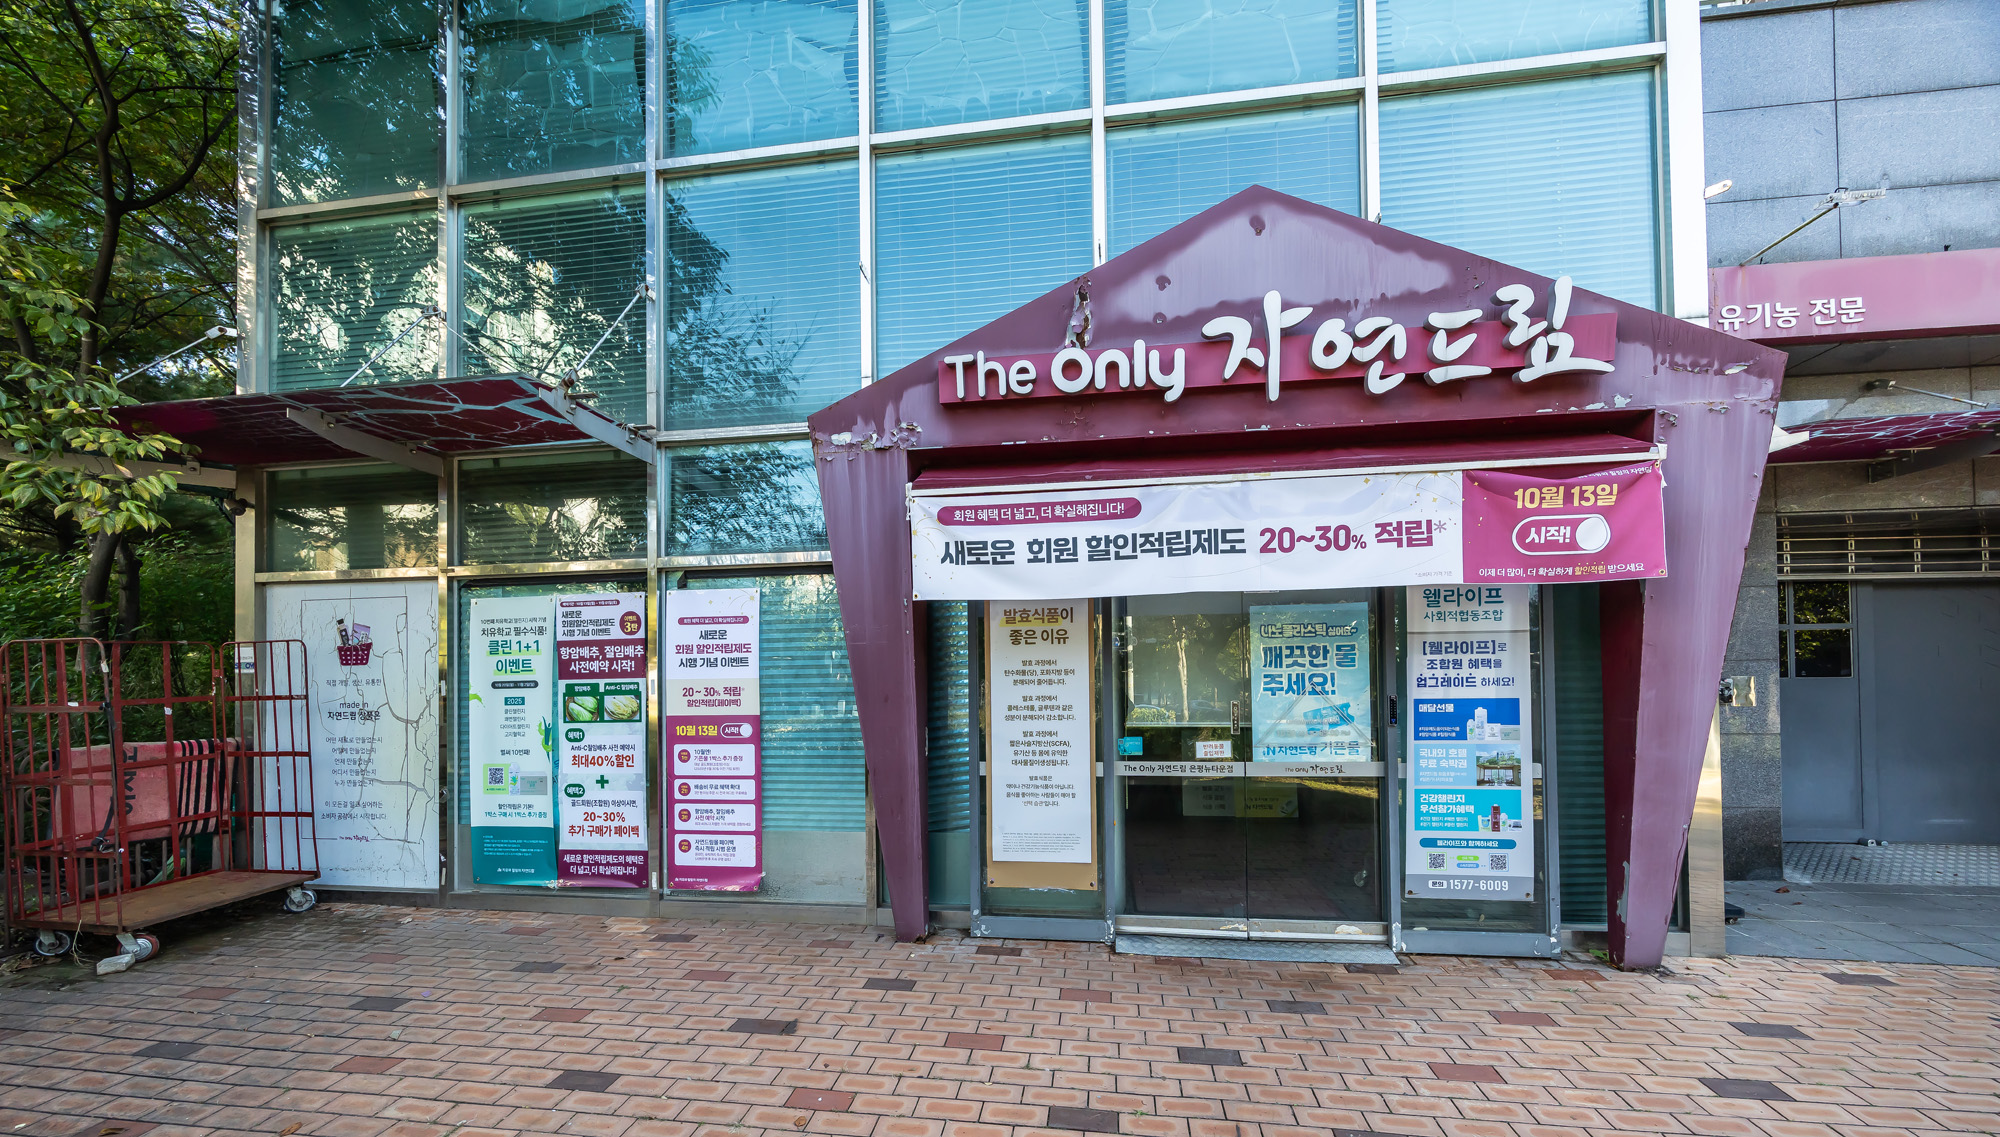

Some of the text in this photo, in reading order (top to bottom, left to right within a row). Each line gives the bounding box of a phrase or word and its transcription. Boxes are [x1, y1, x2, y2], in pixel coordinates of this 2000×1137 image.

[1718, 297, 1867, 331] 유기농 전문
[943, 275, 1616, 402] The Only 자연드림
[1514, 483, 1618, 509] 10월 13일
[953, 502, 1125, 522] 회원 혜택 더 넓고, 더 확실해집니다!
[1525, 526, 1571, 544] 시작!
[941, 539, 1015, 566] 새로운
[1027, 536, 1078, 564] 회원
[1085, 528, 1247, 562] 할인적립제도
[1259, 524, 1367, 554] 20~30%
[1479, 563, 1645, 578] 이제 더 많이, 더 확실하게 할인적립 받으세요
[1422, 586, 1504, 608] 웰라이프
[562, 610, 582, 619] 새로운
[1004, 607, 1074, 625] 발효식품이
[1424, 609, 1504, 622] 사회적협동조합
[562, 619, 615, 628] 회원할인적립제도
[624, 622, 638, 633] 3탄
[481, 626, 547, 637] 치유학교 필수식품!
[562, 628, 611, 637] 시행 기념 이벤트
[699, 629, 727, 640] 새로운
[1260, 623, 1327, 638] 나노플라스틱
[1009, 628, 1069, 646] 좋은 이유
[488, 639, 540, 655] 클린 1+1
[560, 645, 644, 660] 항암배추, 절임배추
[675, 643, 752, 655] 회원 할인적립제도
[1422, 640, 1507, 656] [웰라이프]로
[679, 656, 749, 668] 시행 기념 이벤트
[1262, 643, 1357, 669] 깨끗한 물
[496, 658, 533, 674] 이벤트
[569, 659, 635, 674] 사전예약 시작!
[1426, 658, 1502, 670] 조합원 혜택을
[1063, 668, 1075, 676] 등이
[1262, 672, 1336, 697] 주세요!
[1416, 676, 1515, 688] 업그레이드 하세요!
[340, 701, 360, 709] made
[687, 699, 741, 707] 할인적립(페이백)
[1418, 703, 1454, 713] 매달선물
[328, 711, 357, 721] 자연드림
[568, 731, 583, 740] 혜택1
[675, 725, 695, 736] 10월
[698, 725, 717, 736] 13일
[608, 744, 619, 752] 사전
[1278, 746, 1317, 756] 자연드림
[1419, 748, 1467, 758] 국내외 호텔
[1138, 765, 1156, 774] Only
[1157, 764, 1187, 773] 자연드림
[1189, 764, 1234, 774] 은평뉴타운점
[1310, 765, 1346, 774] 자연드림
[1419, 758, 1467, 769] 무료 숙박권
[567, 786, 584, 795] 혜택2
[1420, 794, 1465, 804] 건강챌린지
[1420, 804, 1475, 814] 우선참가혜택
[583, 811, 626, 823] 20~30%
[568, 824, 640, 838] 추가 구매가 페이백
[1468, 840, 1499, 848] 함께하세요
[563, 854, 645, 864] 새로운 할인적립제도의 혜택은
[570, 865, 576, 874] 더
[1449, 879, 1509, 891] 1577-6009
